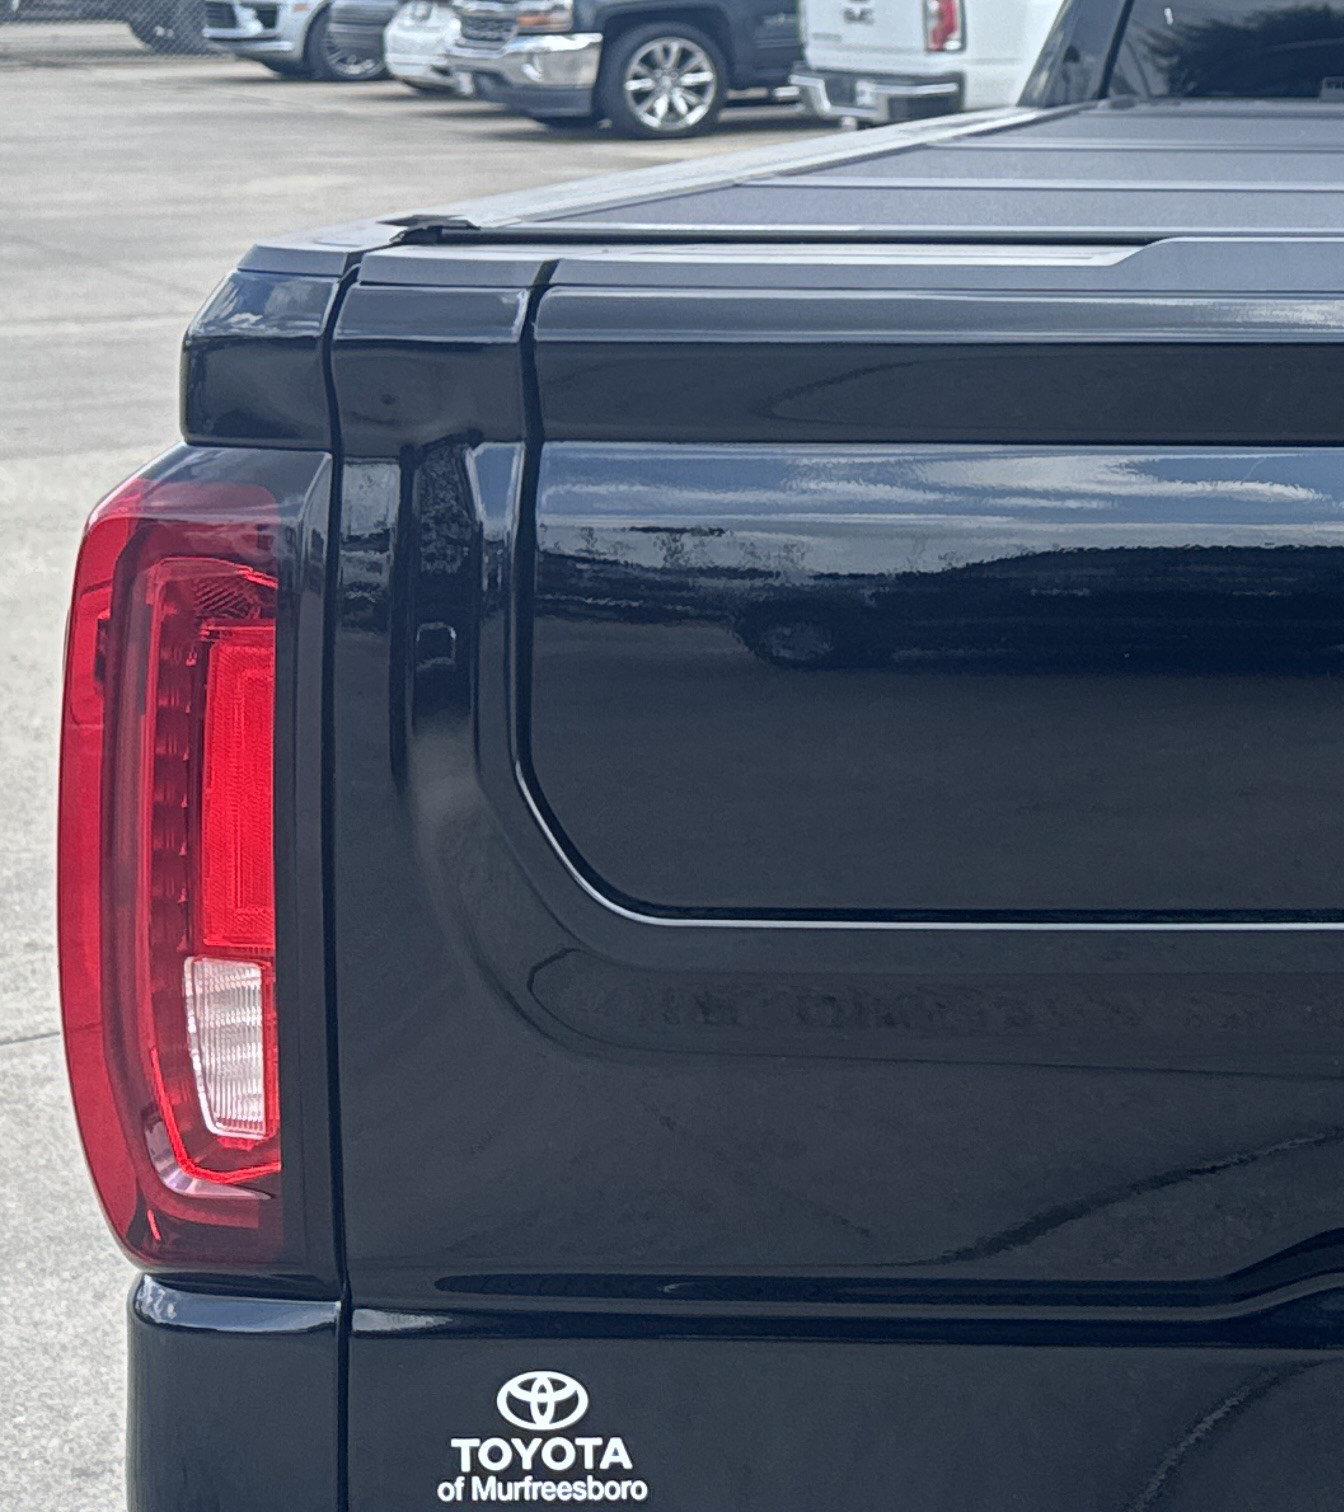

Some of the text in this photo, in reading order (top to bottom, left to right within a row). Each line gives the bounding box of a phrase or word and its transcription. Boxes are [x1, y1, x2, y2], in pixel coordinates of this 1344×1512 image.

[450, 1437, 633, 1472] TOYOTA
[437, 1474, 648, 1502] of Murfreesboro
